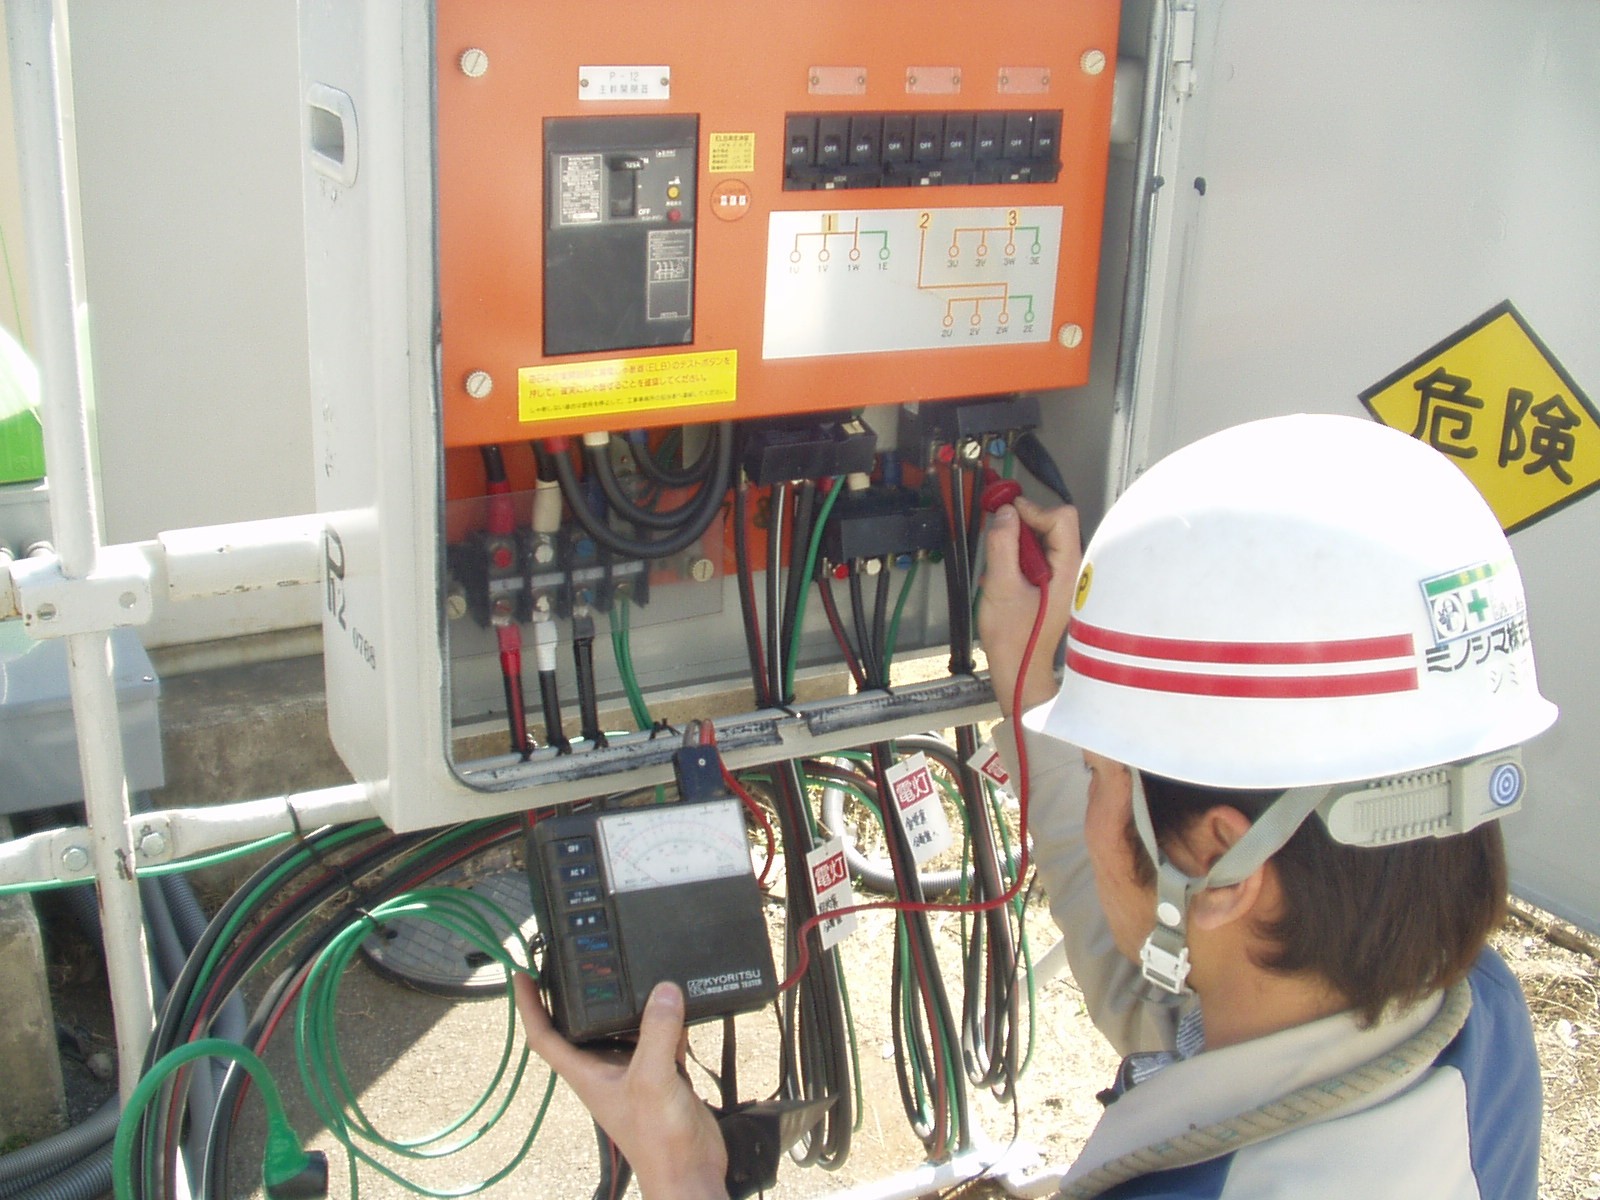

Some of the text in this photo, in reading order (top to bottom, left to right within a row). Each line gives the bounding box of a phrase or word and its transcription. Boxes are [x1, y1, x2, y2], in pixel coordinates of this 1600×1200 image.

[919, 212, 929, 229] 2
[1008, 210, 1018, 226] 3
[1410, 366, 1582, 486] 危険
[896, 772, 930, 802] 電灯
[815, 857, 844, 887] 電灯
[704, 969, 761, 986] KYORITSU
